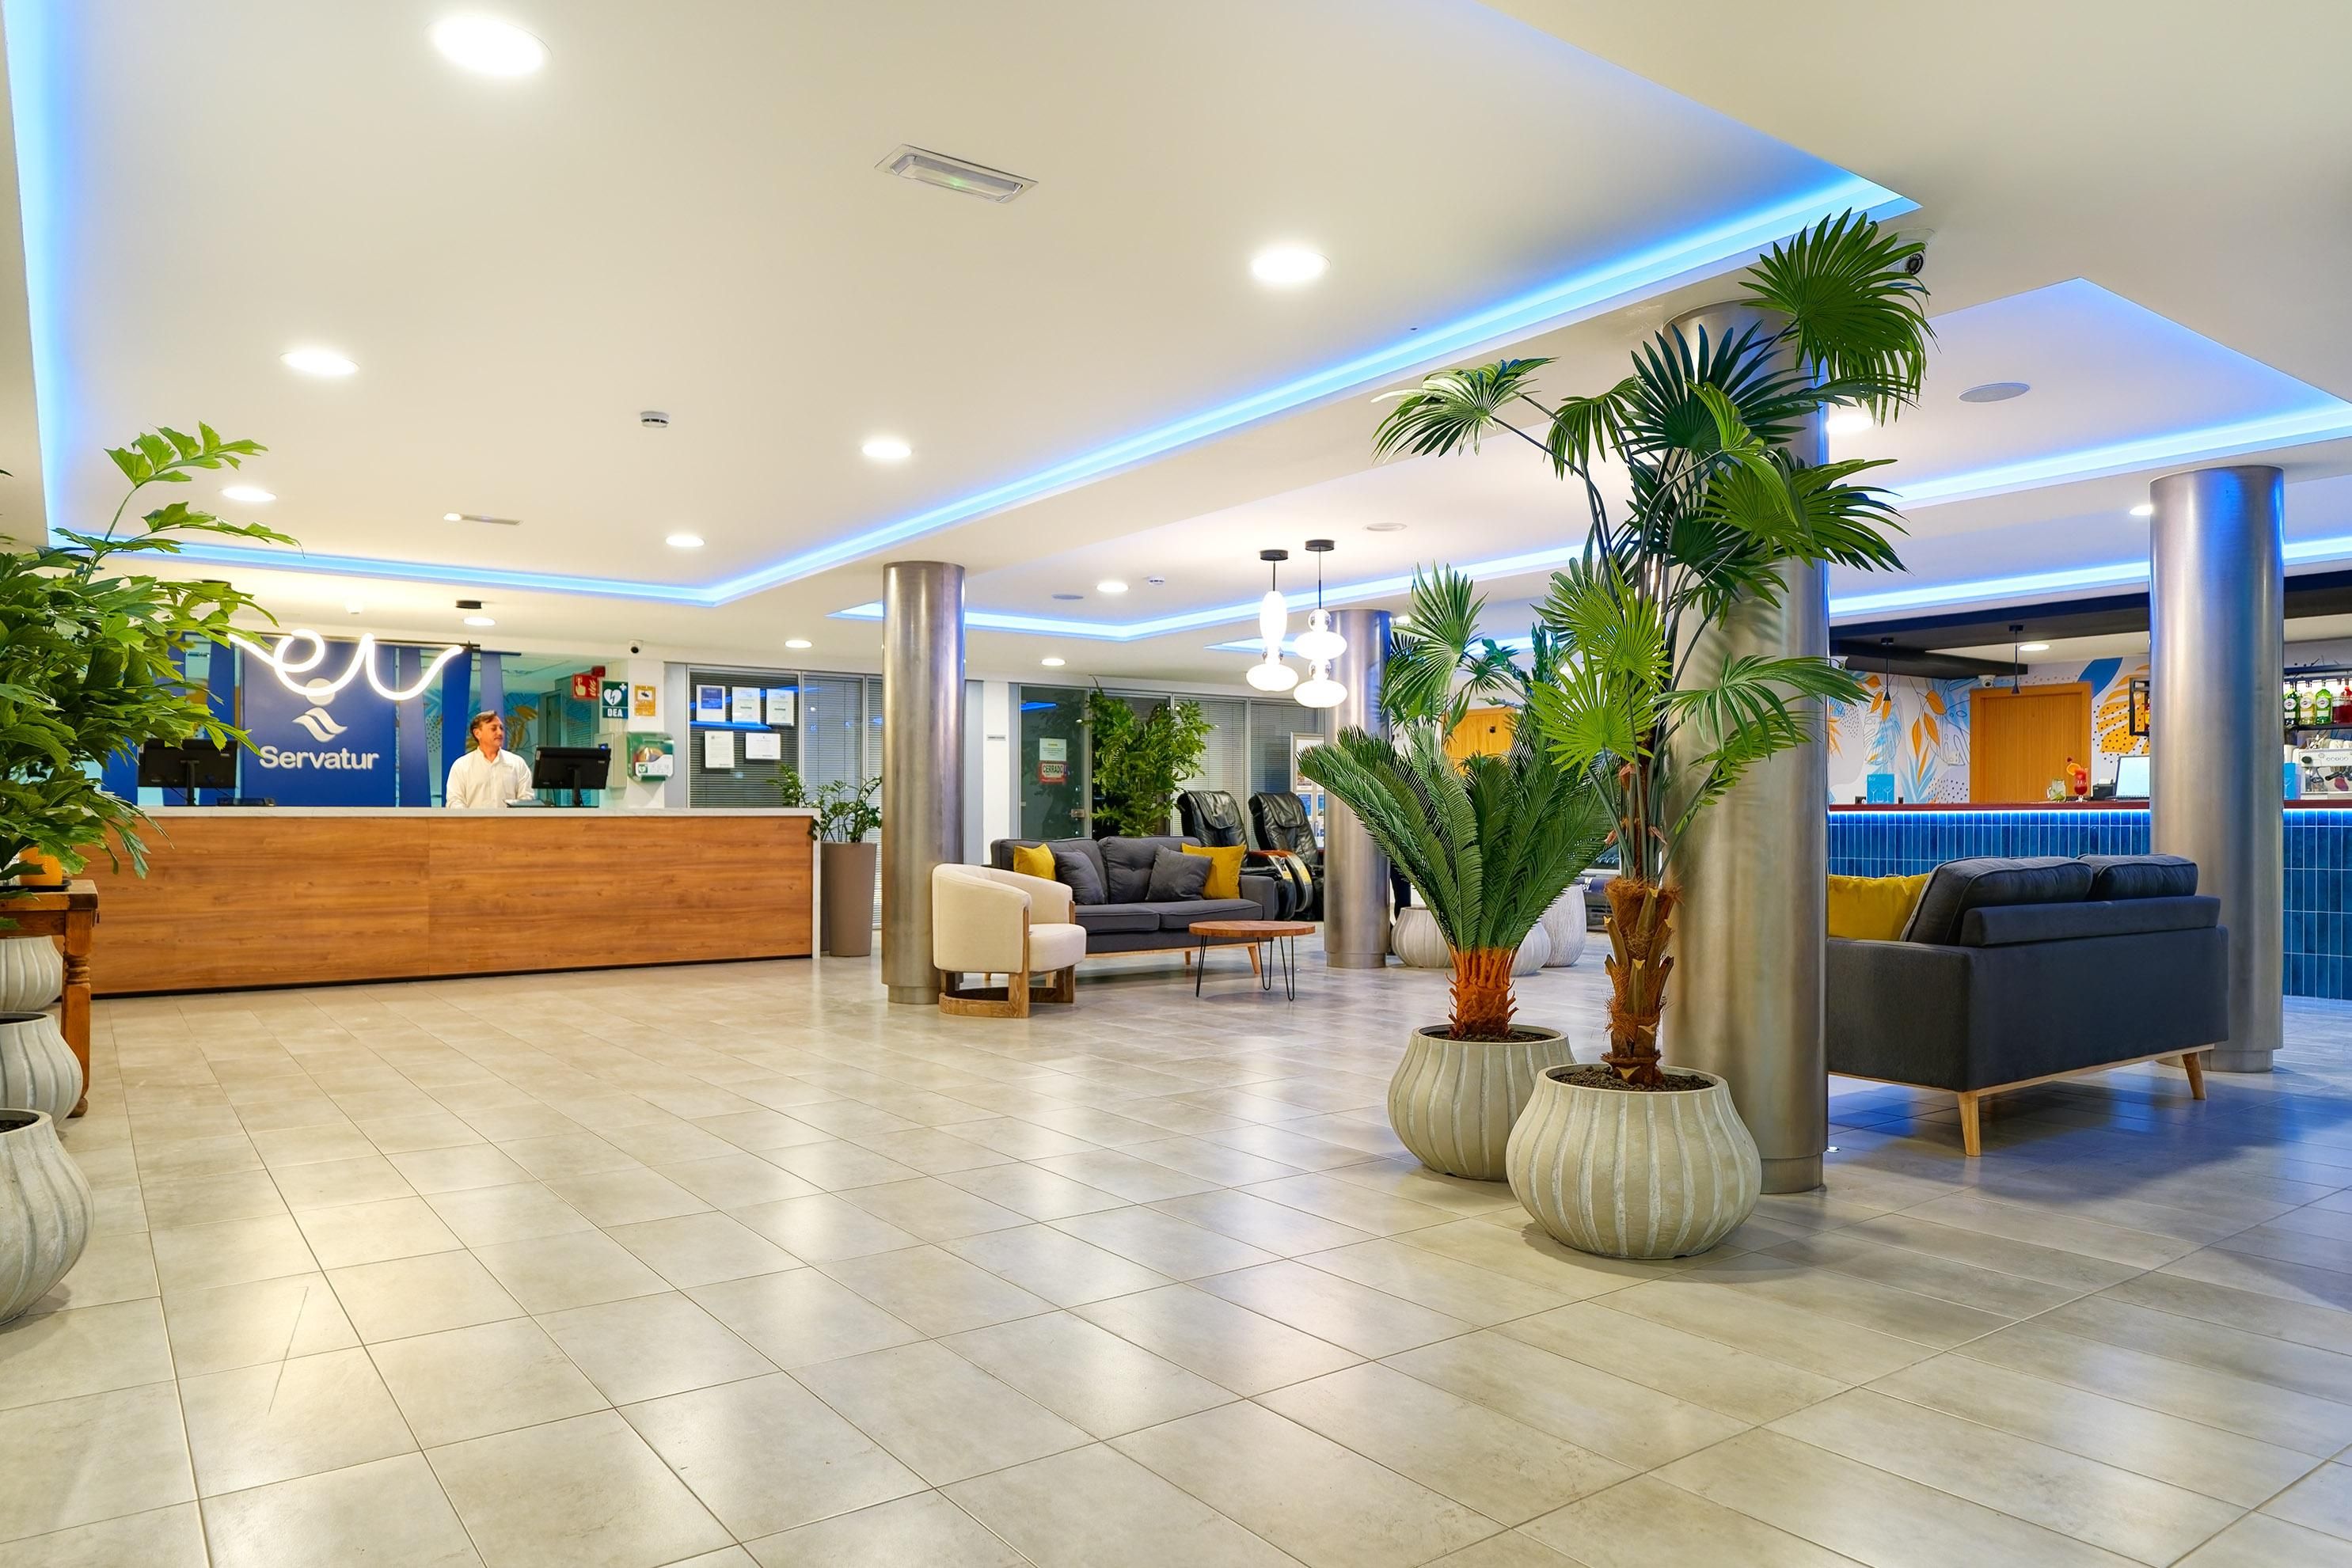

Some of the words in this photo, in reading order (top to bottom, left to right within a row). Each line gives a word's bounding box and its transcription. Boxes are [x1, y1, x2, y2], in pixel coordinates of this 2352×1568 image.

[607, 708, 623, 717] DEA
[259, 745, 380, 769] Servatur
[1043, 765, 1063, 773] CERRADO
